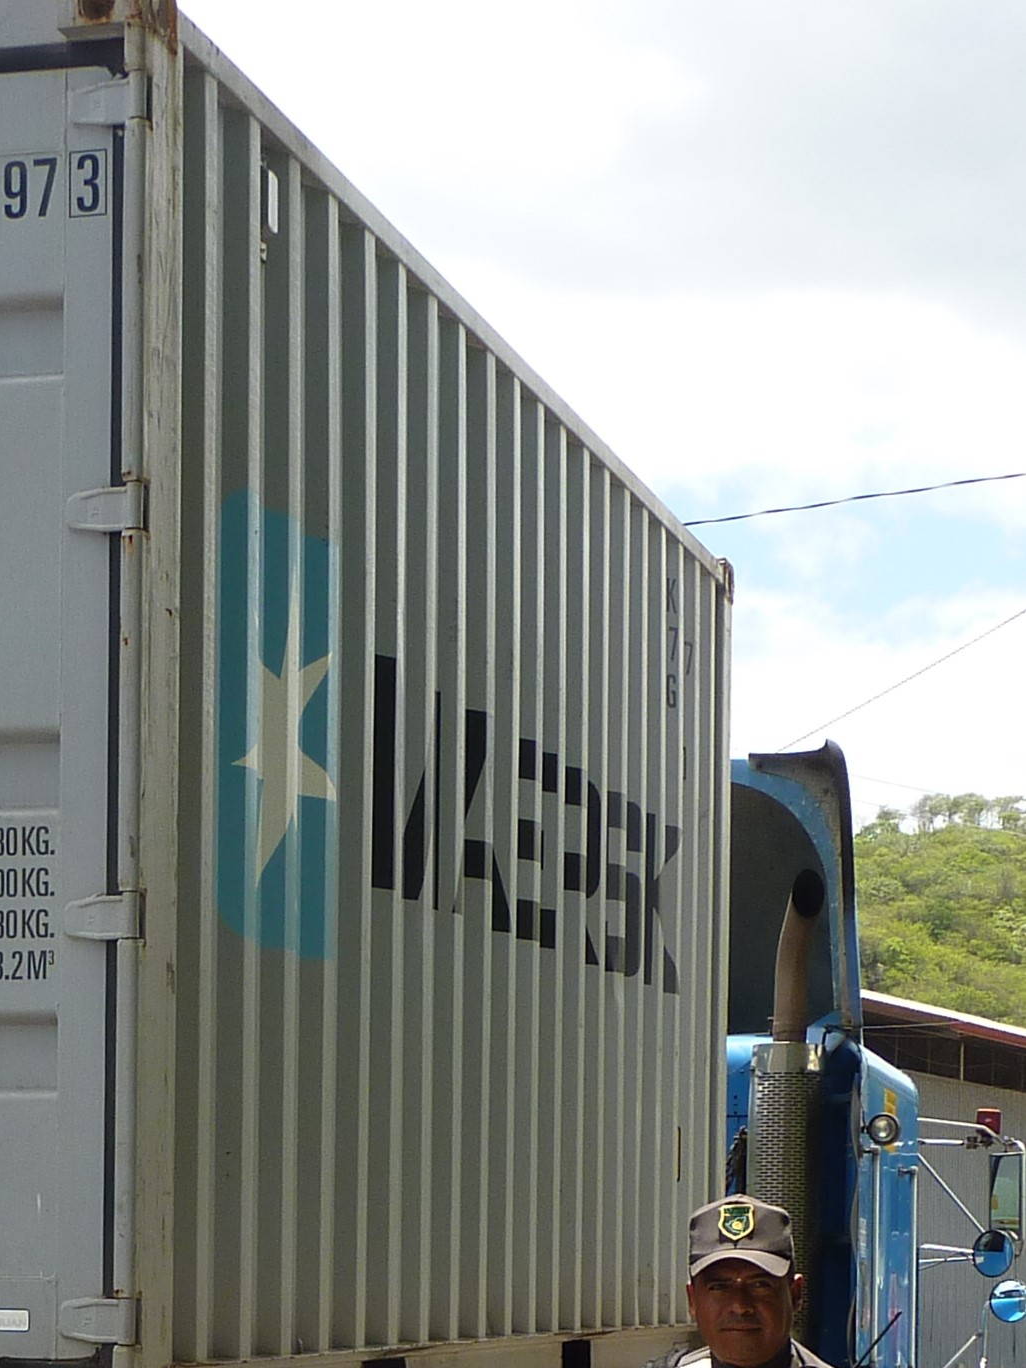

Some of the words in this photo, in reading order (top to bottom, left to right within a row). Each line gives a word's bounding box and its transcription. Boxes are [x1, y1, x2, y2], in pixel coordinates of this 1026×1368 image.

[76, 154, 99, 212] 3
[22, 826, 56, 856] KG.
[22, 867, 56, 898] KG.
[22, 908, 56, 939] KG.
